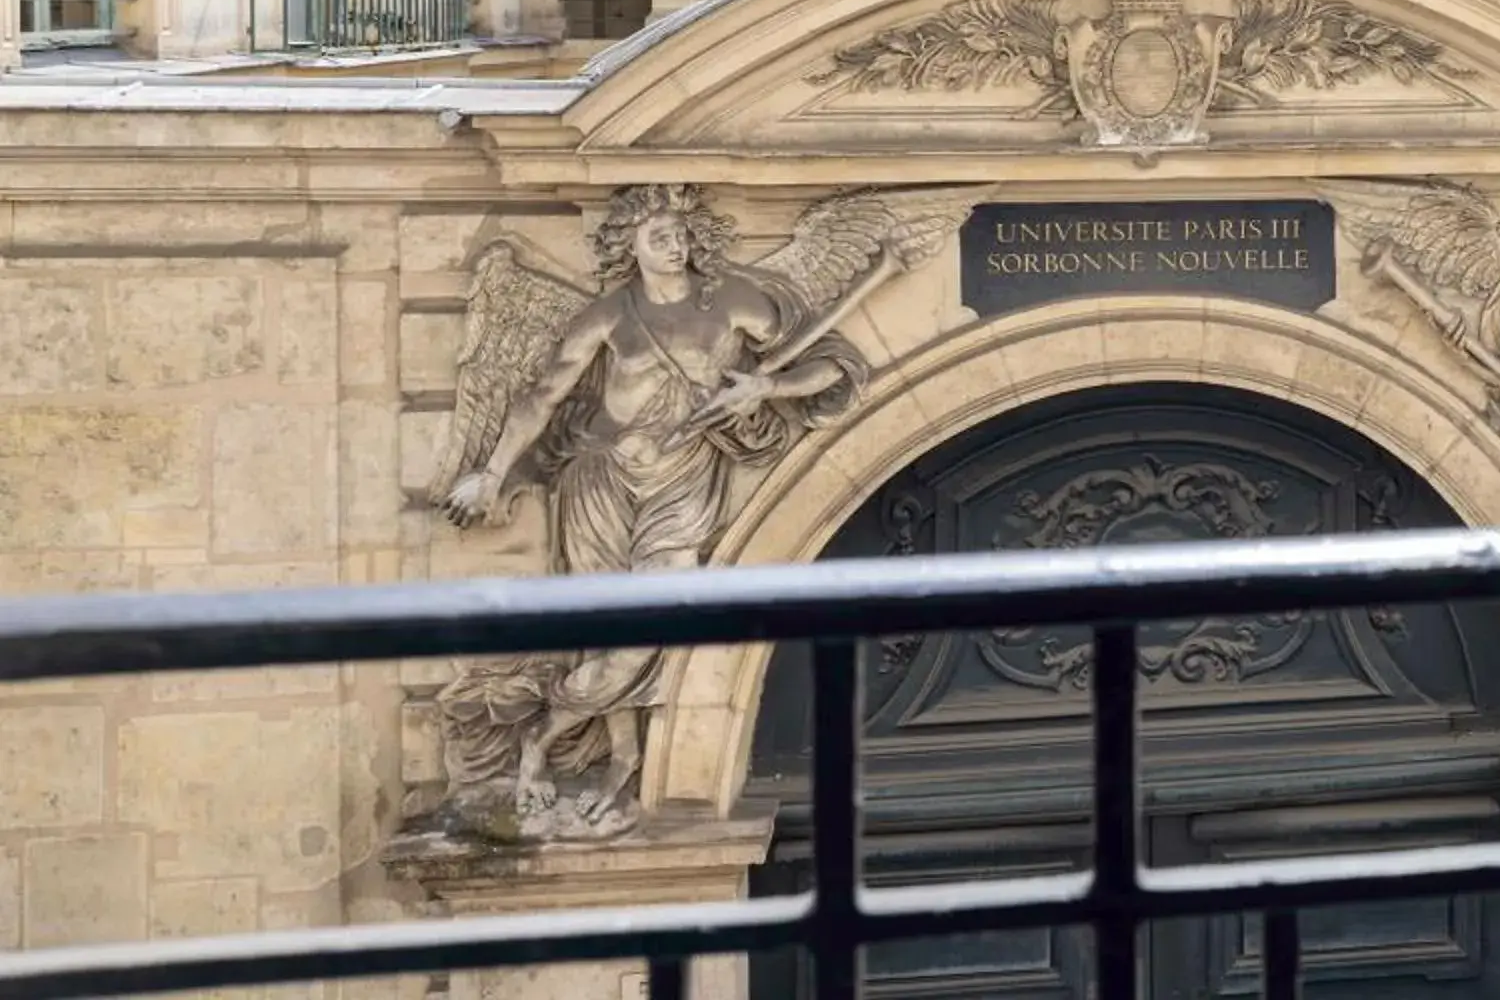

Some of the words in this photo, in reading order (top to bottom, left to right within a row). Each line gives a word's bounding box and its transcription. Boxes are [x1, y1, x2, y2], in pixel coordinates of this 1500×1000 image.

[996, 220, 1173, 243] UNIVERSITE
[1184, 218, 1262, 241] PARIS
[1271, 218, 1301, 239] III
[987, 251, 1146, 275] SORBONNE
[1156, 249, 1310, 271] NOUVELLE
